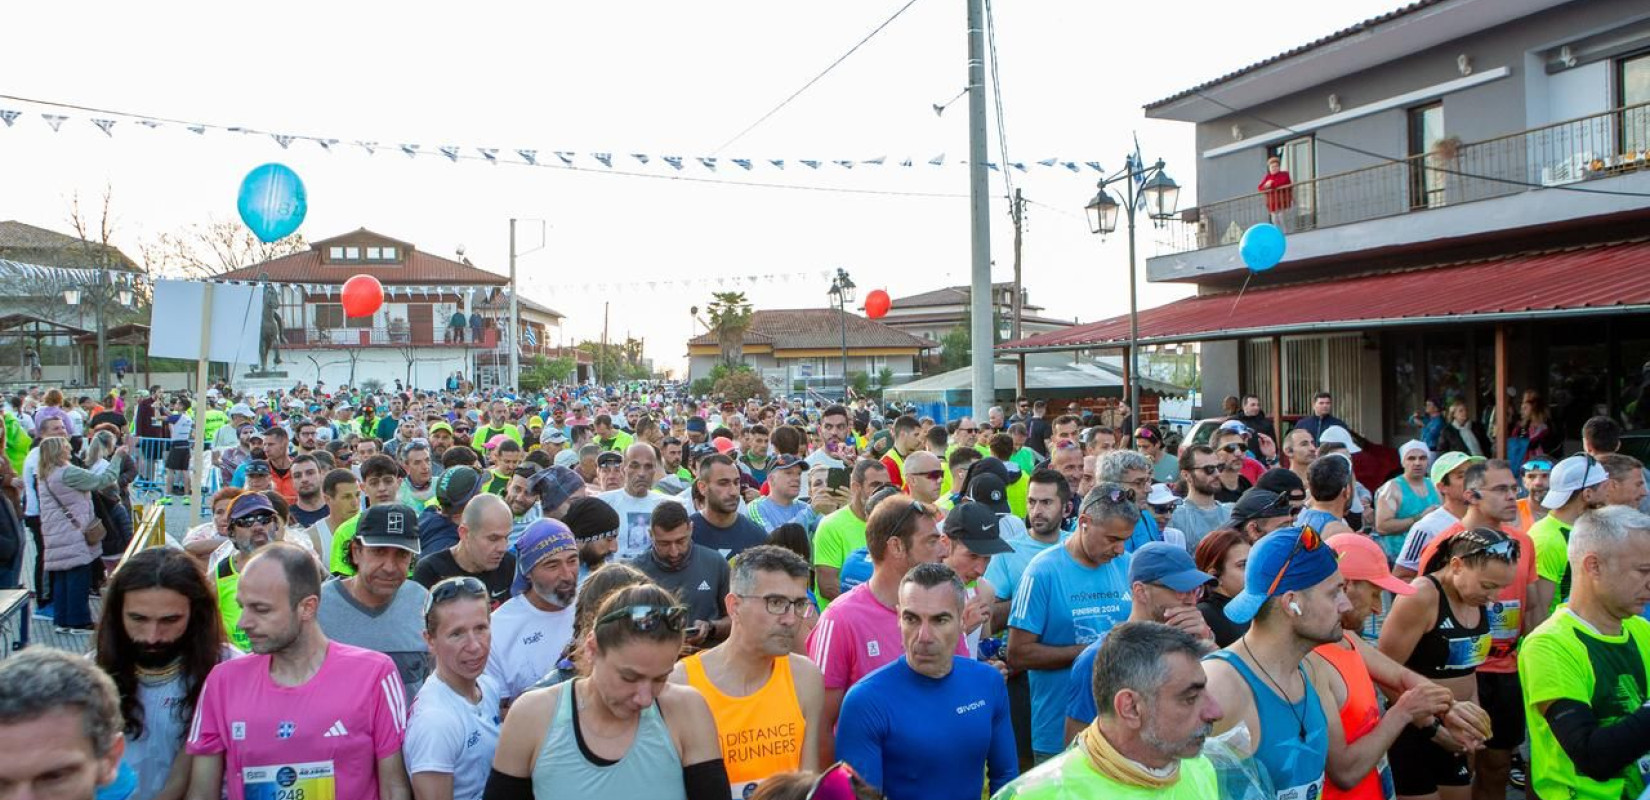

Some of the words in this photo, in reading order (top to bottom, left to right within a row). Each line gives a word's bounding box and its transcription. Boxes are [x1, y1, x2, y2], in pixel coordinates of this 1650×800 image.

[726, 722, 796, 747] DISTANCE
[727, 738, 796, 763] RUNNERS
[271, 788, 305, 800] 1248
